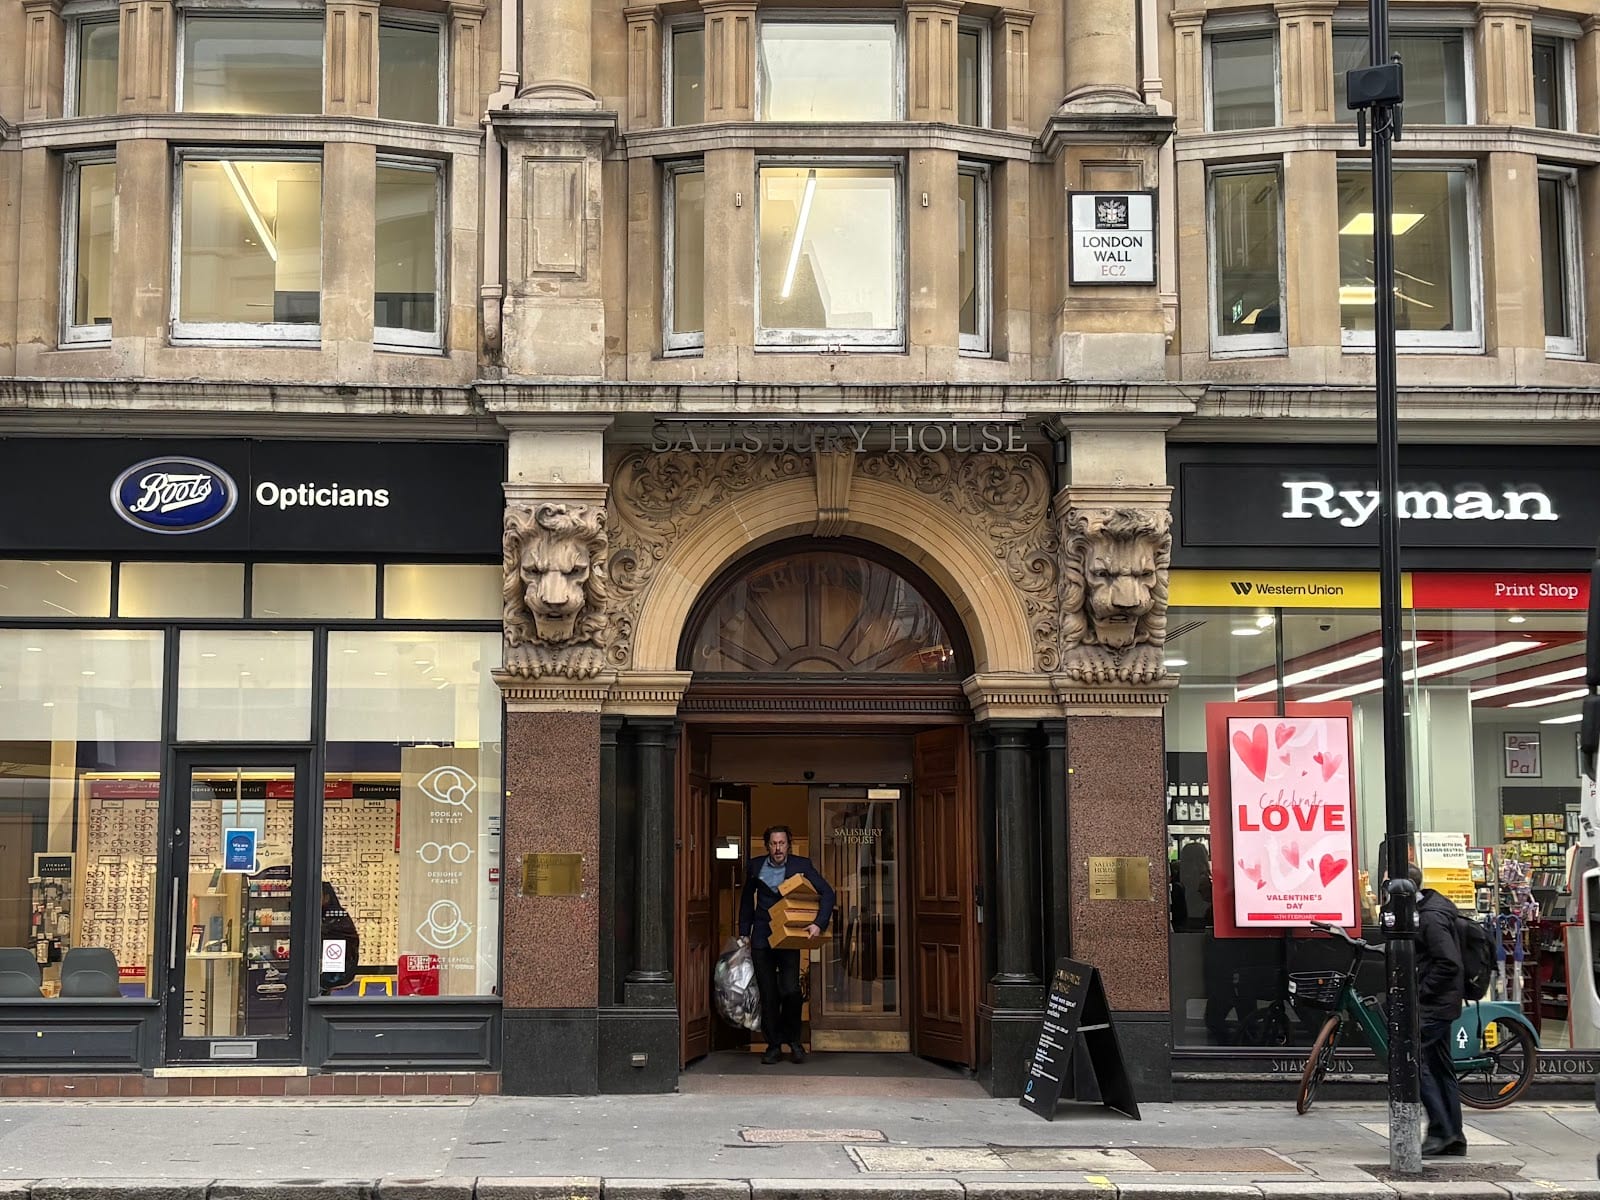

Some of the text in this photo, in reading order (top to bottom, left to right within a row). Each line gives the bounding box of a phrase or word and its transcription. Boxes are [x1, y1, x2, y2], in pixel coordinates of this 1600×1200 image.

[1082, 236, 1143, 248] LONDON
[1093, 250, 1132, 262] WALL
[1101, 265, 1126, 277] EC2
[650, 423, 1028, 453] SALISBURY HOUSE
[130, 473, 213, 513] Boots
[255, 481, 390, 511] Opticians
[1281, 481, 1559, 528] Ryman
[1256, 583, 1344, 596] Western Union
[1495, 583, 1579, 599] Print Shop
[1510, 758, 1537, 774] Pal
[1238, 804, 1345, 832] LOVE
[834, 828, 883, 837] SALISBURY
[844, 836, 875, 845] HOUSE
